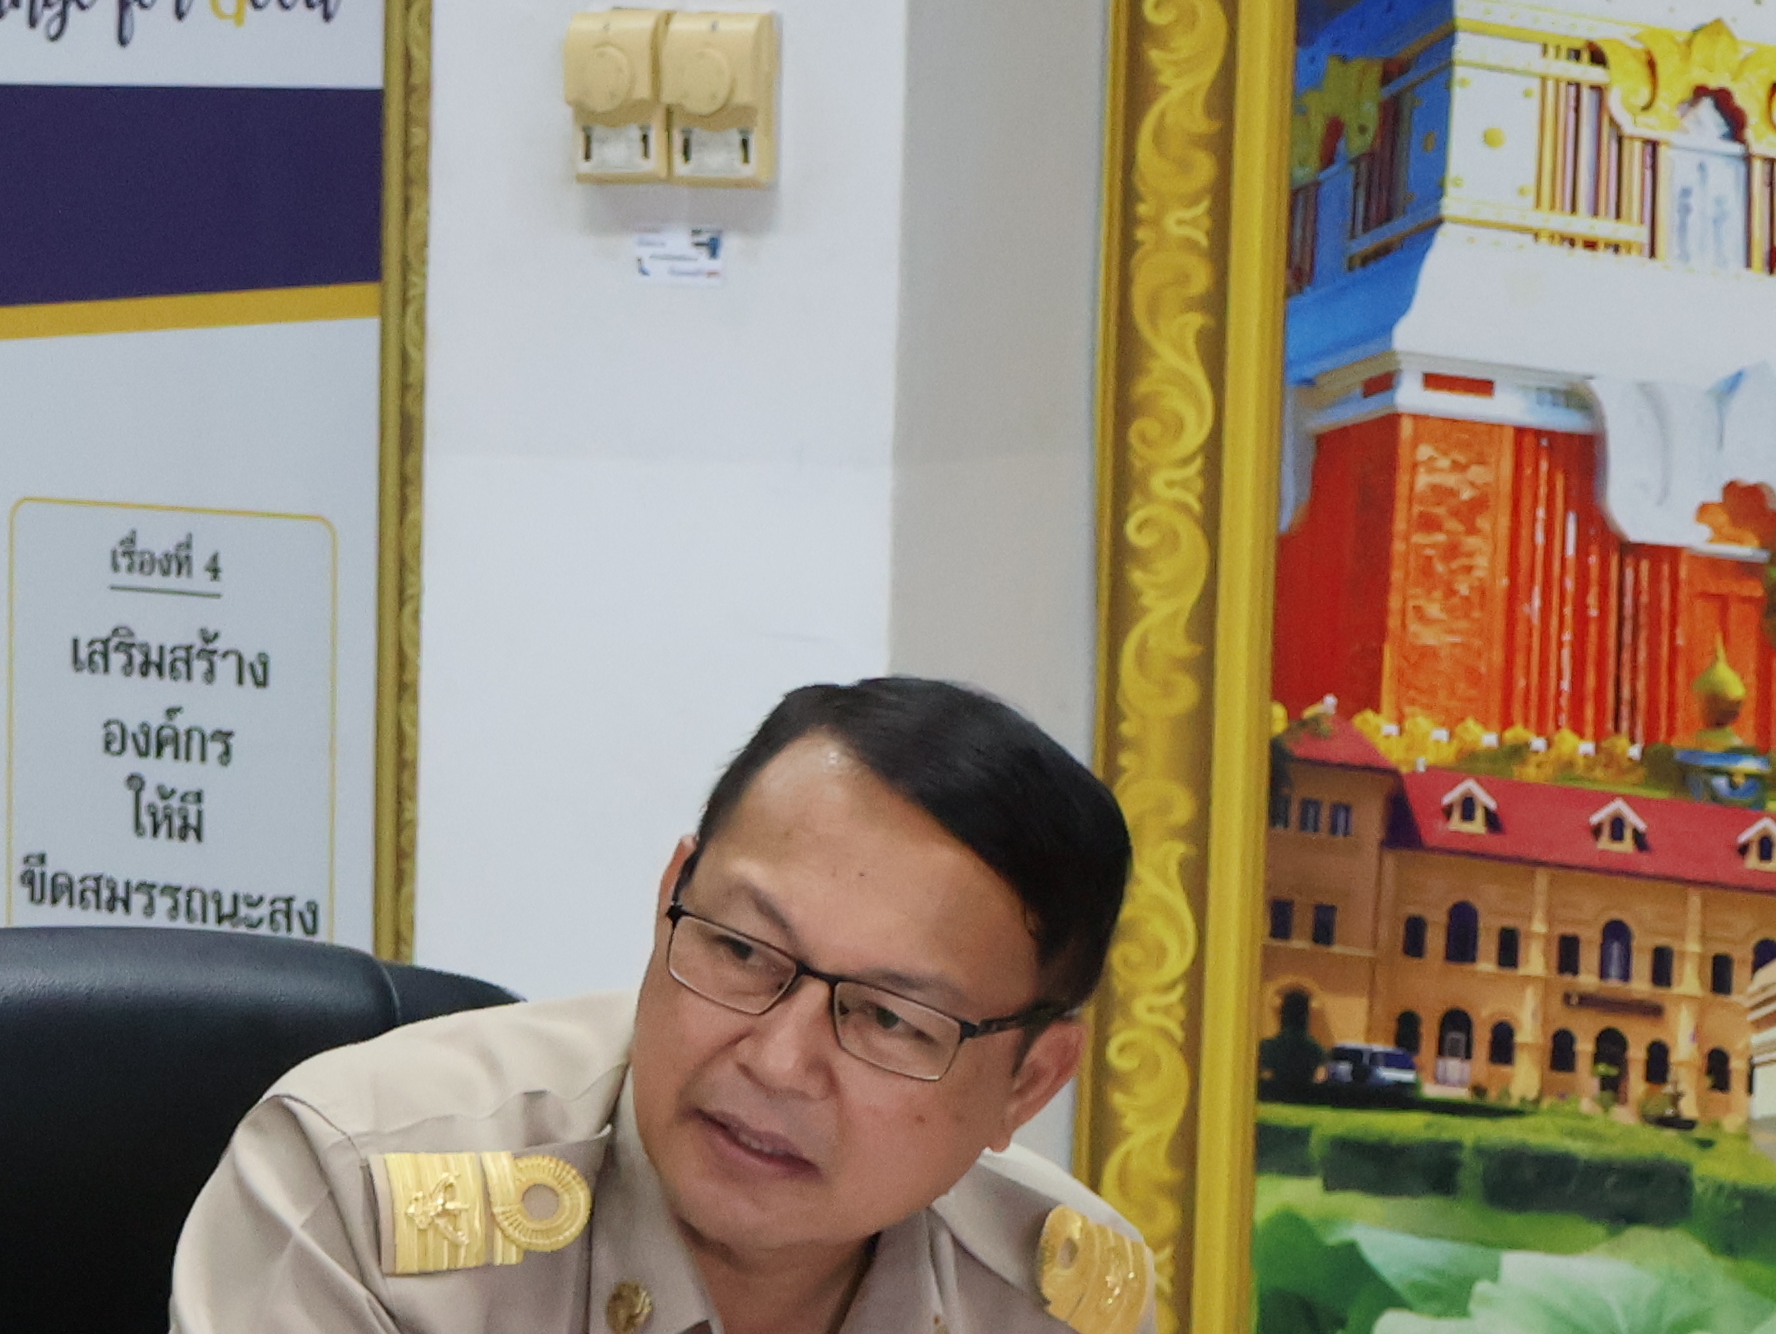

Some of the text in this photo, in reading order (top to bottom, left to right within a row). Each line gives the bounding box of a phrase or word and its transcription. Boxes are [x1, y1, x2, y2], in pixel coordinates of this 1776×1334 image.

[110, 529, 222, 583] เรื่องที่ 4
[70, 627, 270, 690] เสริมสร้าง
[102, 707, 235, 767] องค์กร
[126, 775, 204, 844] ให้มี
[20, 853, 321, 938] ขีดสมรรถนะสง
